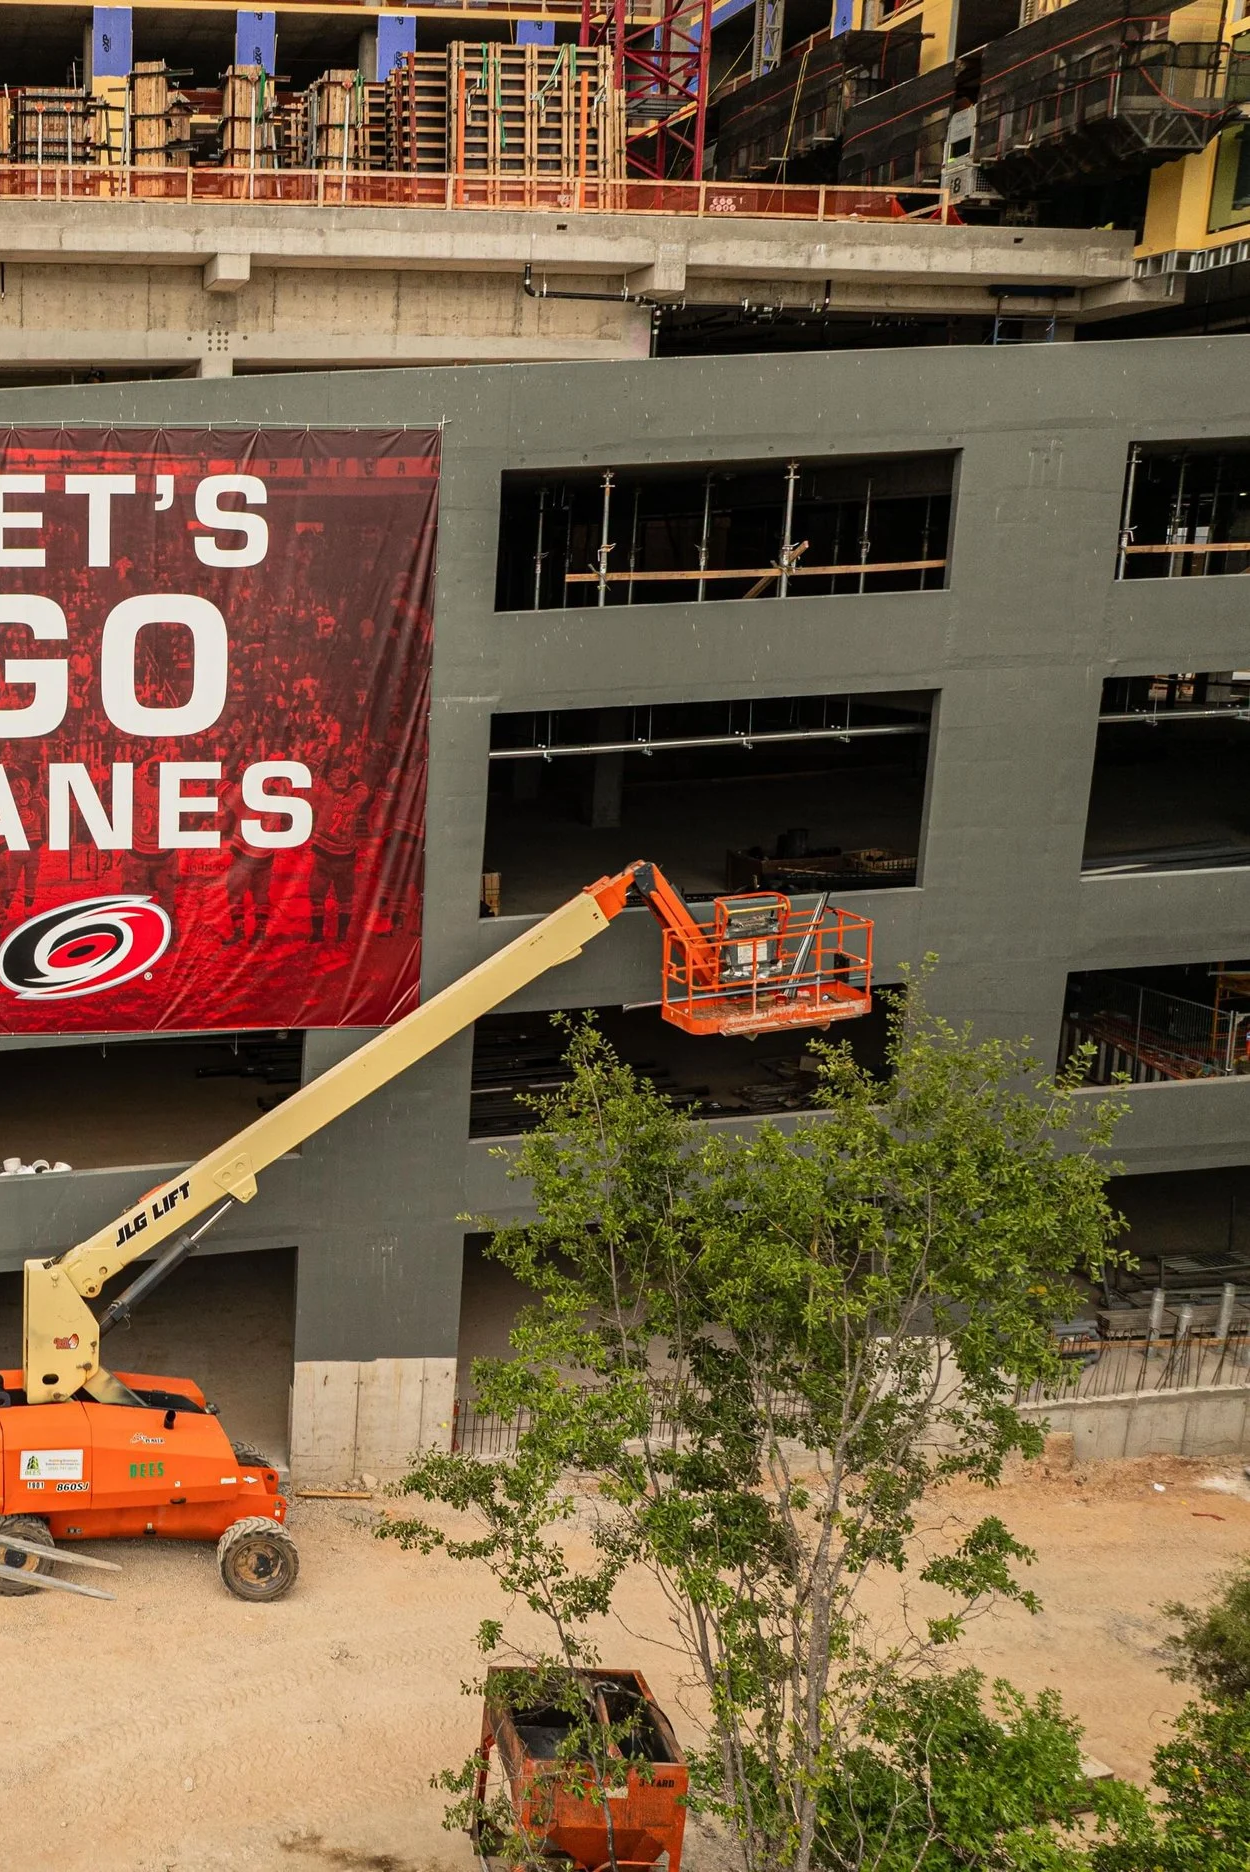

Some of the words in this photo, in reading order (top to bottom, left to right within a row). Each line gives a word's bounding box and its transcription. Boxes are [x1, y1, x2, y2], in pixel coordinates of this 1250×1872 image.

[102, 34, 110, 53] eXP
[116, 1212, 148, 1247] JLG
[152, 1181, 190, 1220] LIFT
[129, 1462, 165, 1478] BEES
[57, 1482, 89, 1492] 860SJ
